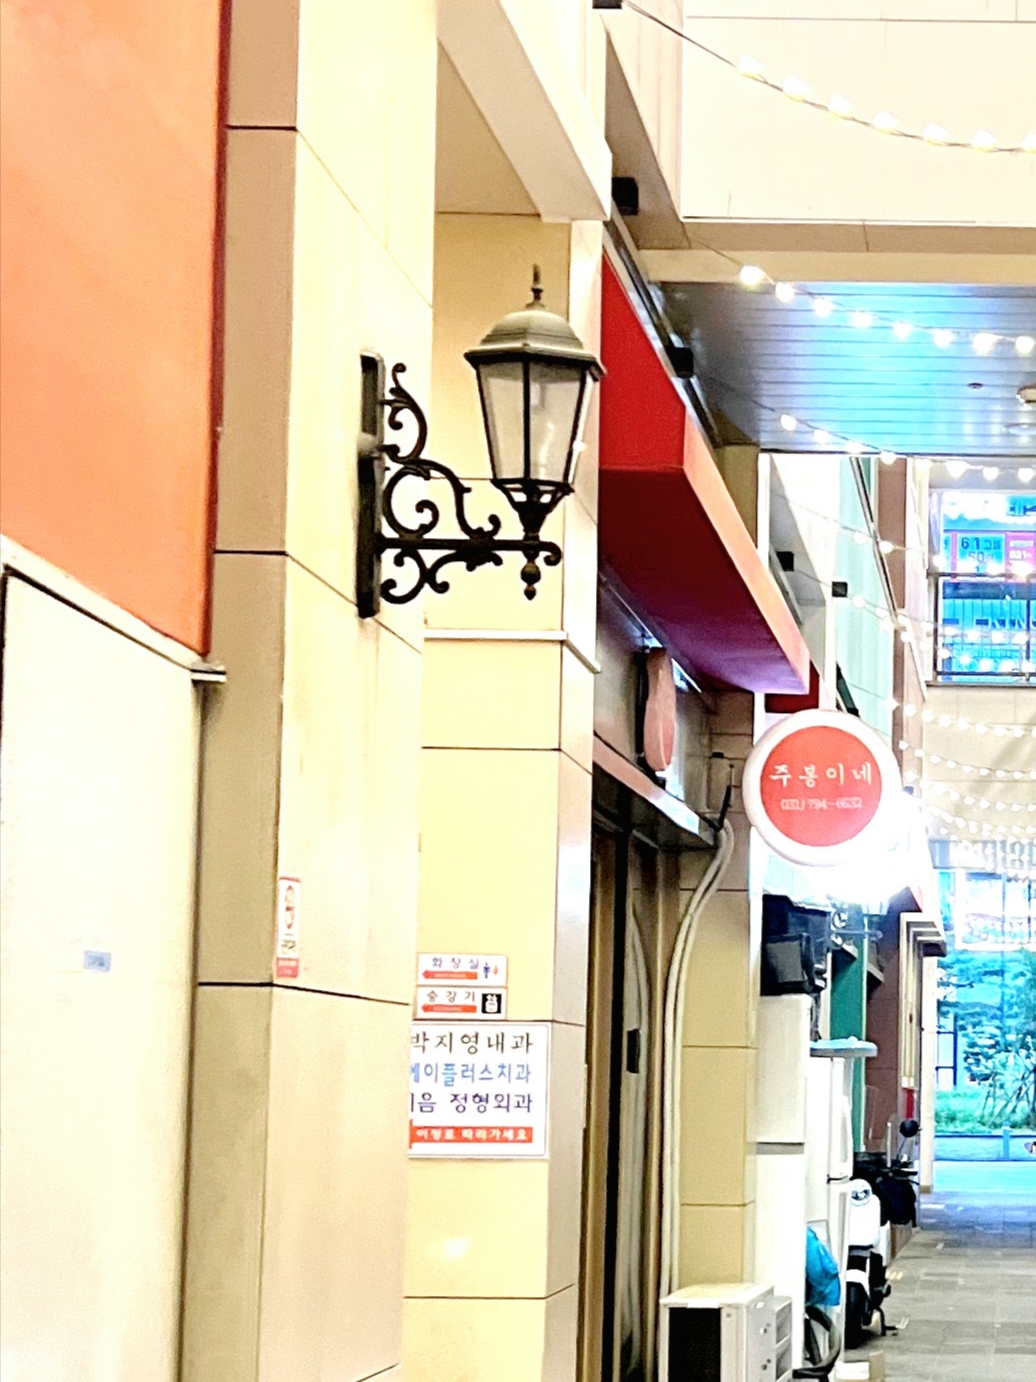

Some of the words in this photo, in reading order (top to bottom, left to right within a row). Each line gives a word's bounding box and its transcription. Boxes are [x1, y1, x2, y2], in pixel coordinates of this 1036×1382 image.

[769, 762, 873, 788] 주봉이네
[432, 957, 480, 970] 화장실
[427, 990, 475, 1003] 승강기
[412, 1031, 533, 1055] 박지영내과
[450, 1092, 533, 1114] 정형외과
